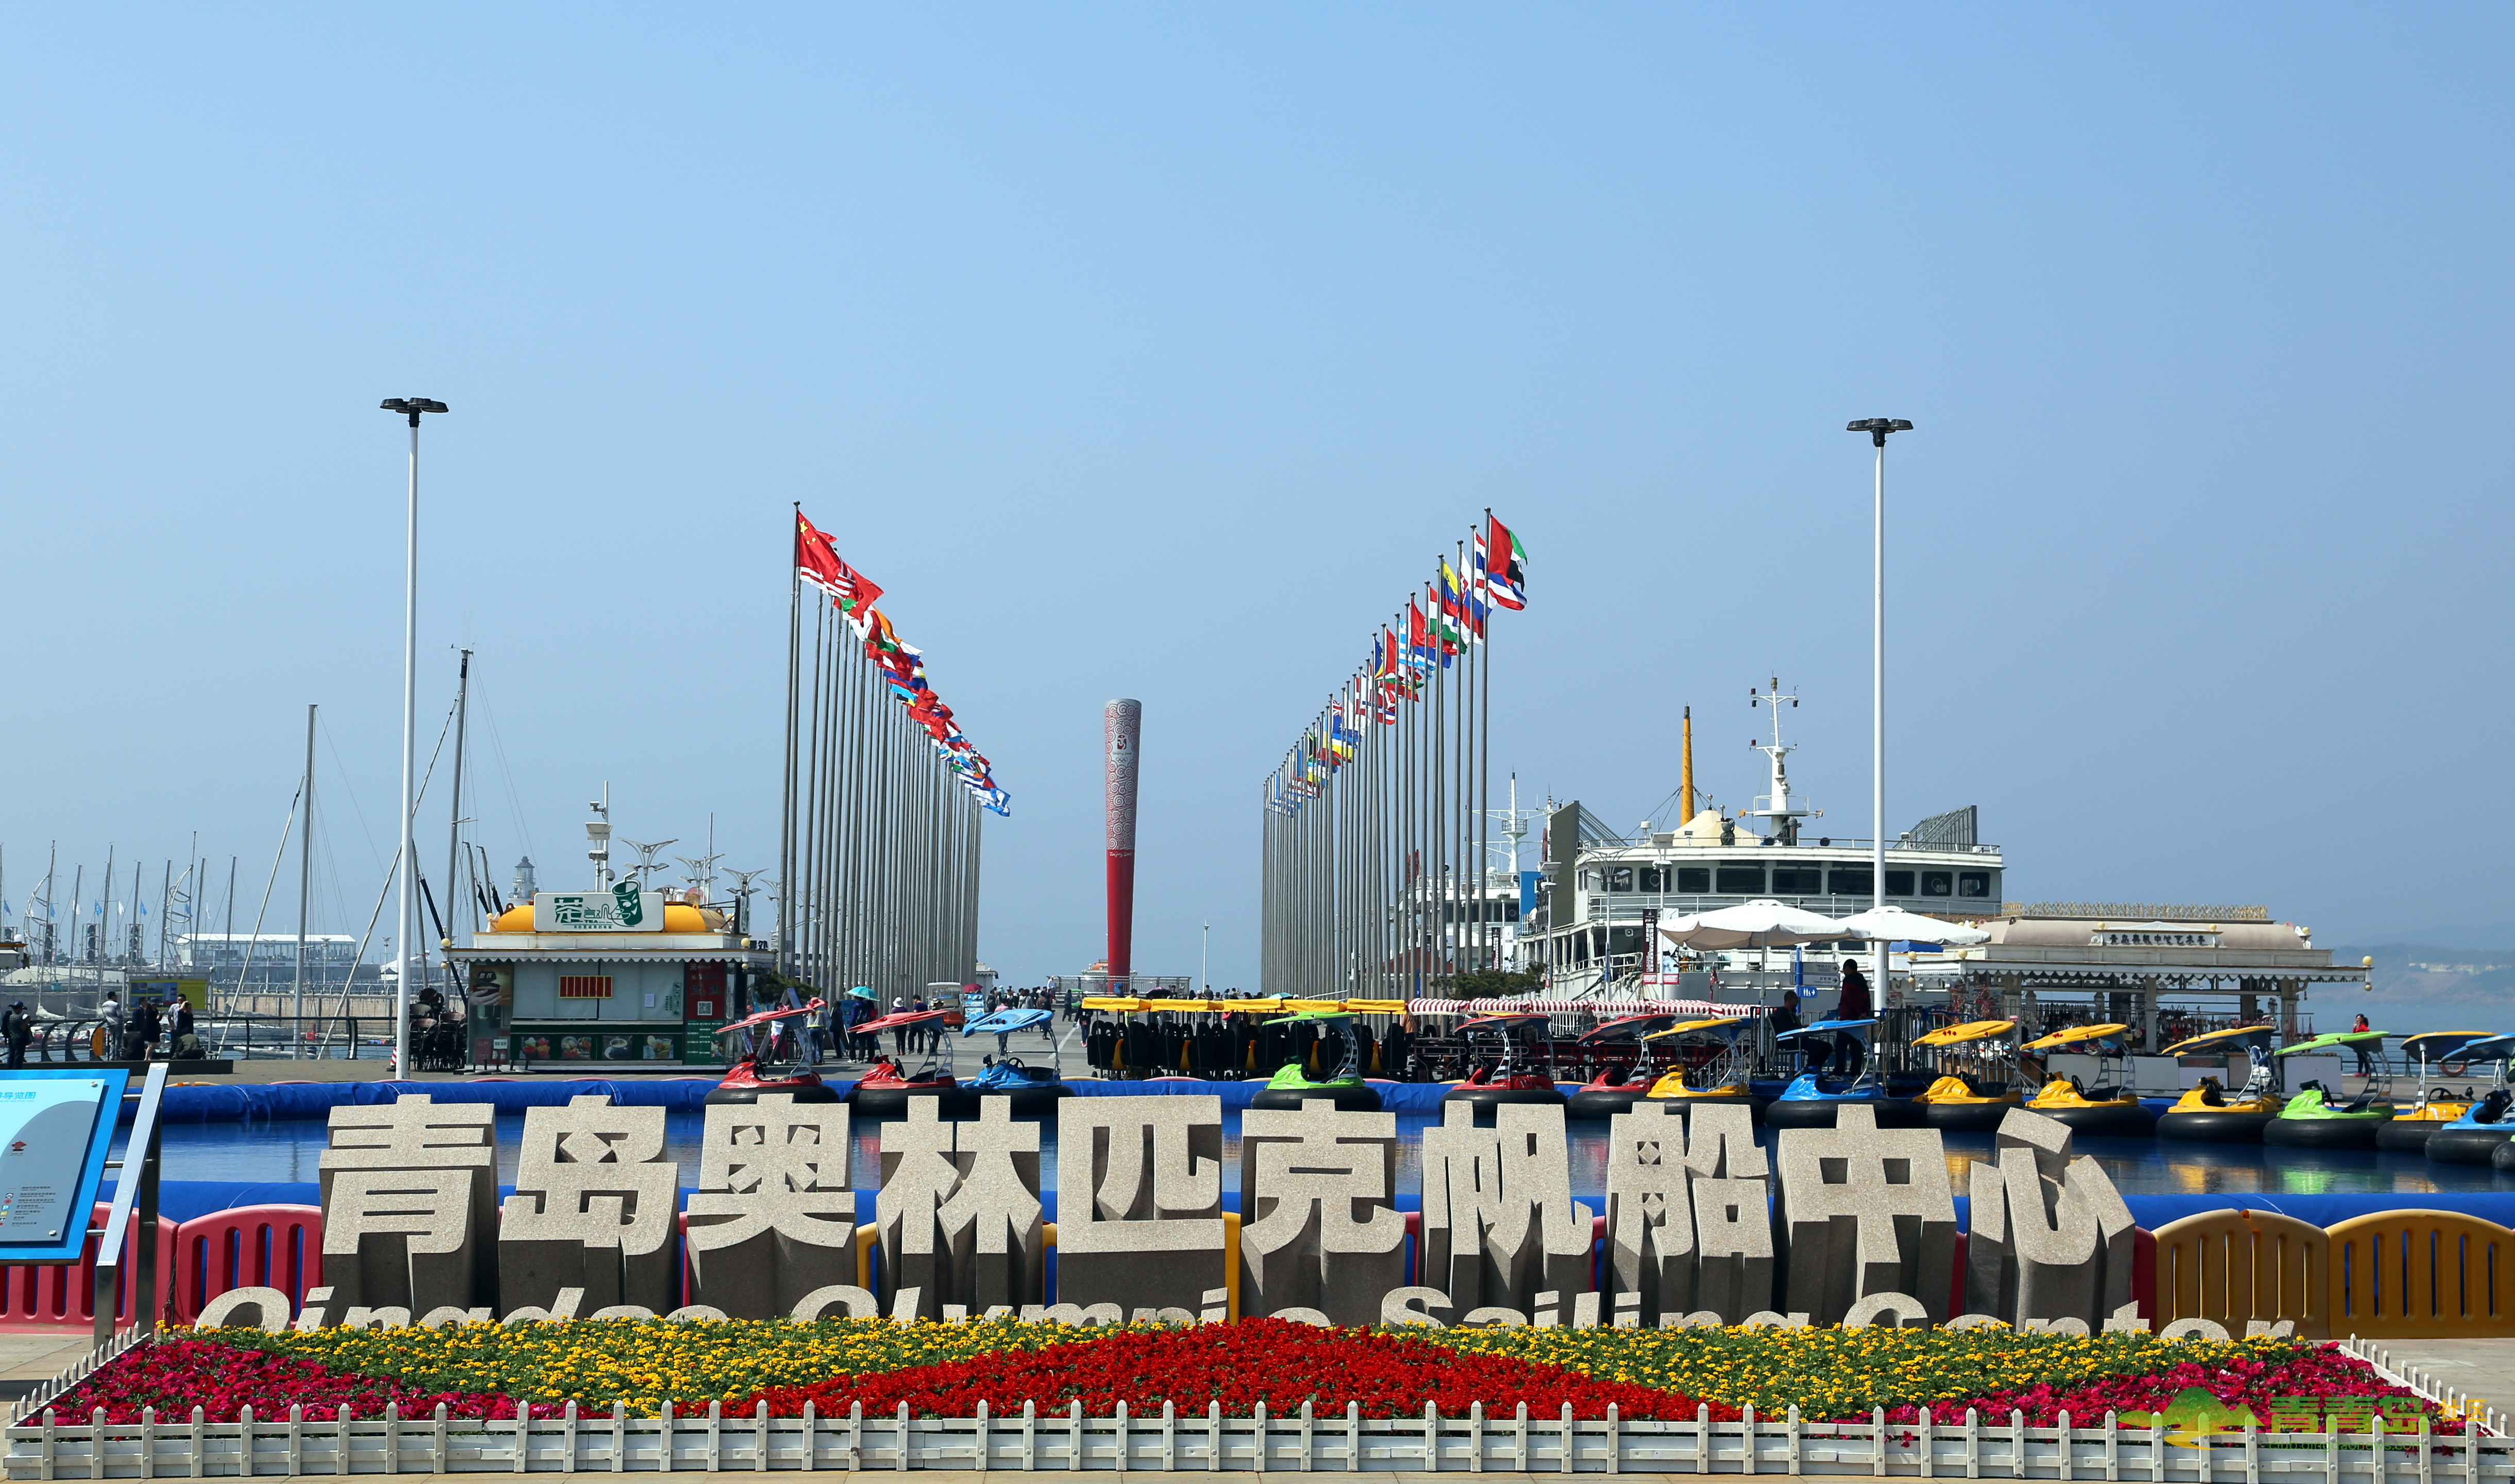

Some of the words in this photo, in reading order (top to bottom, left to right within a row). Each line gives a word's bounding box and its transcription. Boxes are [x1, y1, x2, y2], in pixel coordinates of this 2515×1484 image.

[320, 1092, 2137, 1266] 青岛奥林匹克帆船中心
